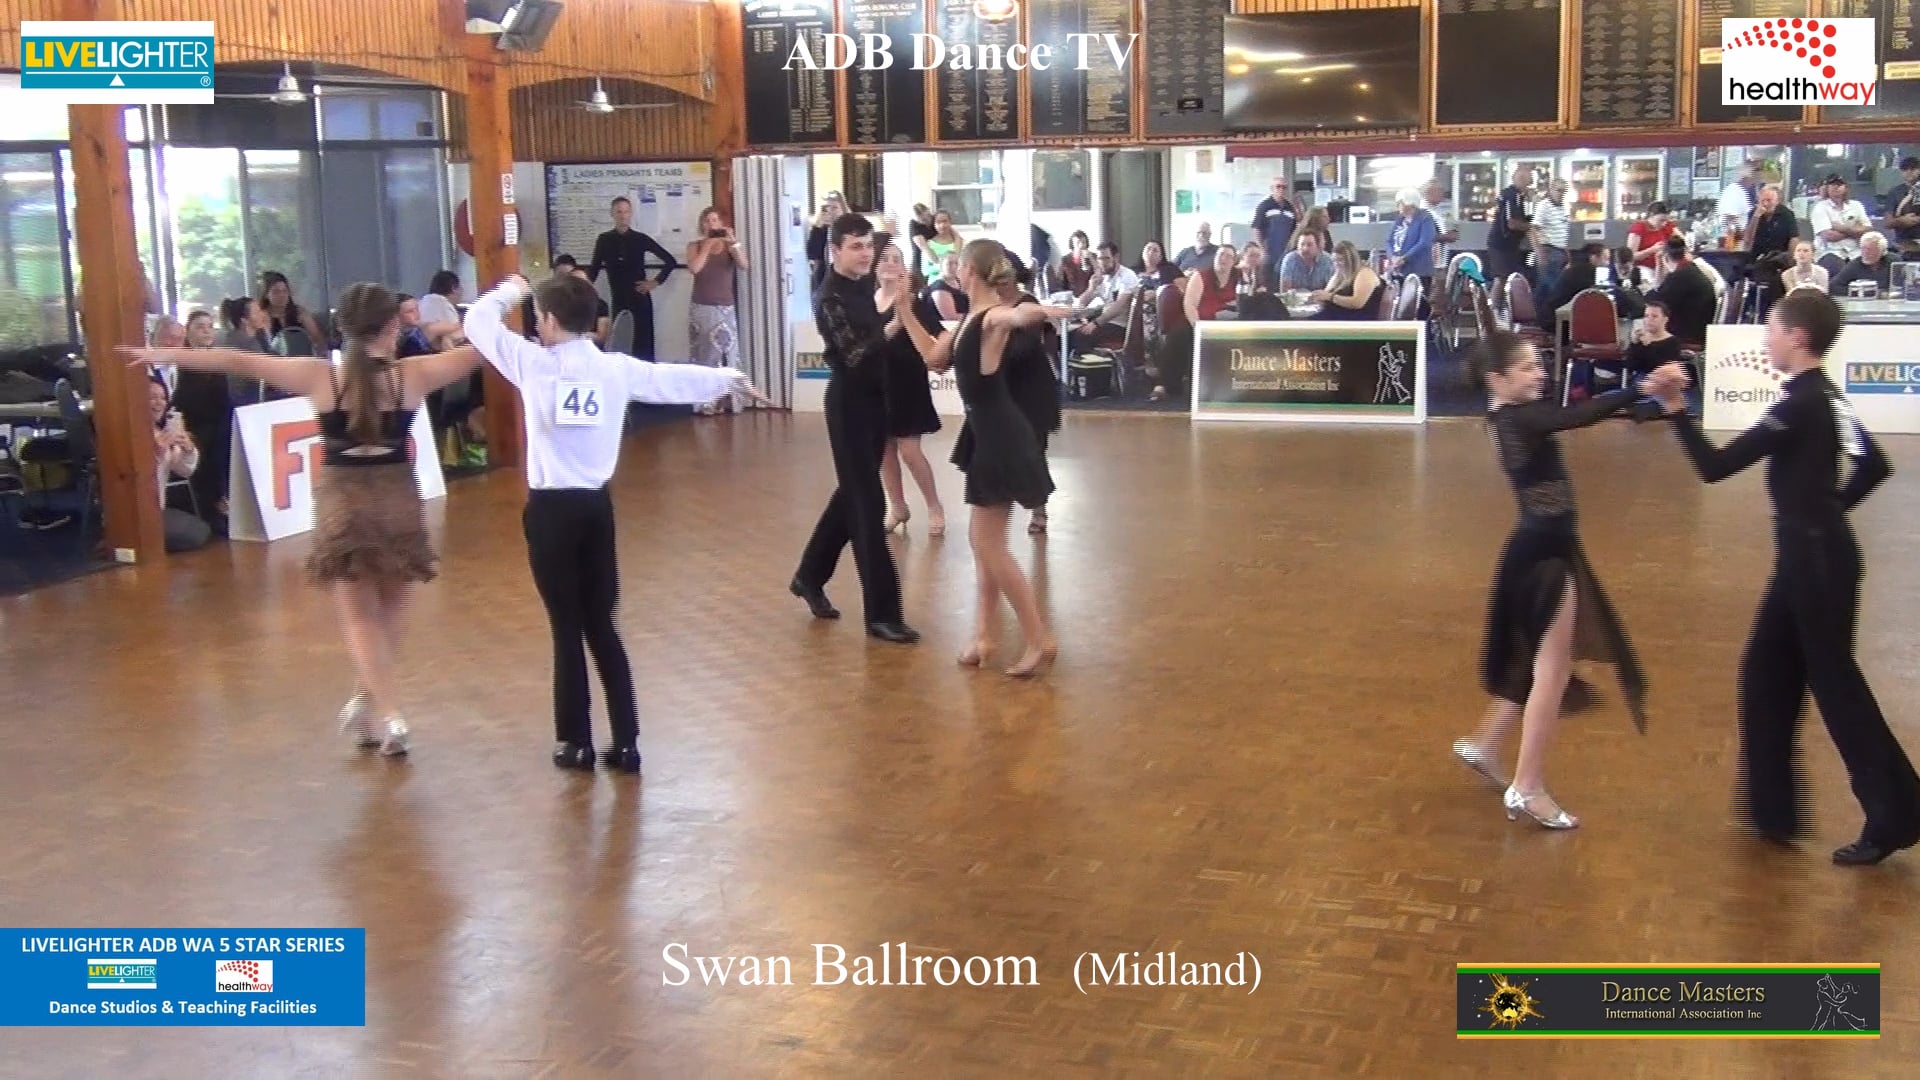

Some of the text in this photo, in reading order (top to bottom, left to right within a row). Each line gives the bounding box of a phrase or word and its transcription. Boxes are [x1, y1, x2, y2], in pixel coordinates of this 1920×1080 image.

[1230, 348, 1342, 373] Dance Masters
[1847, 365, 1920, 382] LIVELIG
[562, 387, 601, 417] 46
[1713, 386, 1781, 404] health
